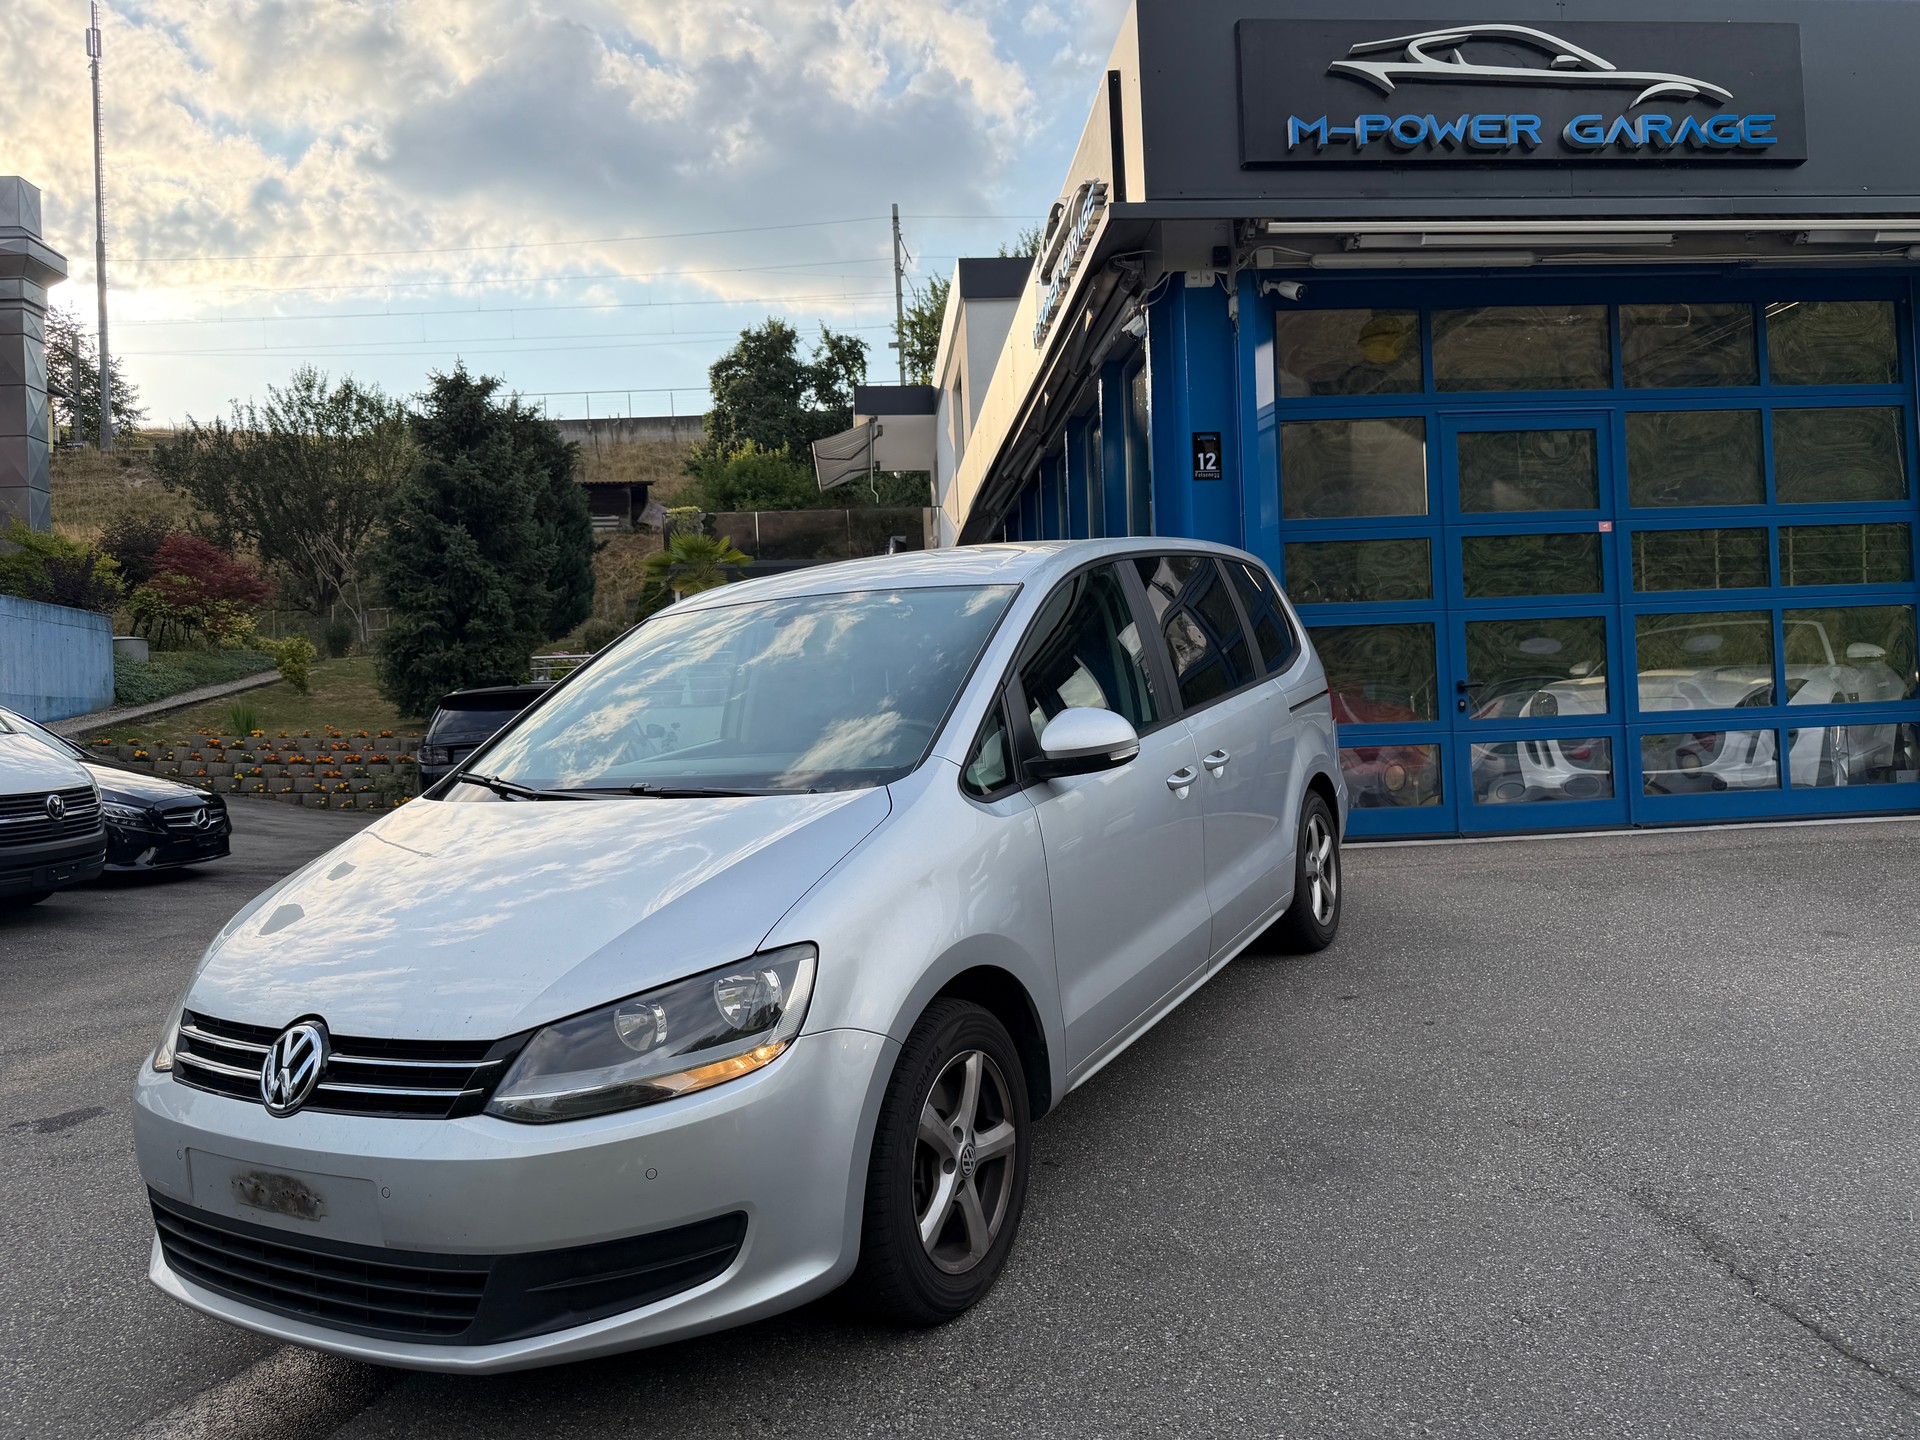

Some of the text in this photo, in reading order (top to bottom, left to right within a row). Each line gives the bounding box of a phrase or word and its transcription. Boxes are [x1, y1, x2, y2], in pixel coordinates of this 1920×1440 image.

[1288, 114, 1778, 149] M-POWER GARAGE
[1062, 183, 1096, 278] GARAGE
[1197, 452, 1217, 470] 12
[263, 1026, 321, 1108] VW
[906, 1046, 943, 1123] YOKOHAMA
